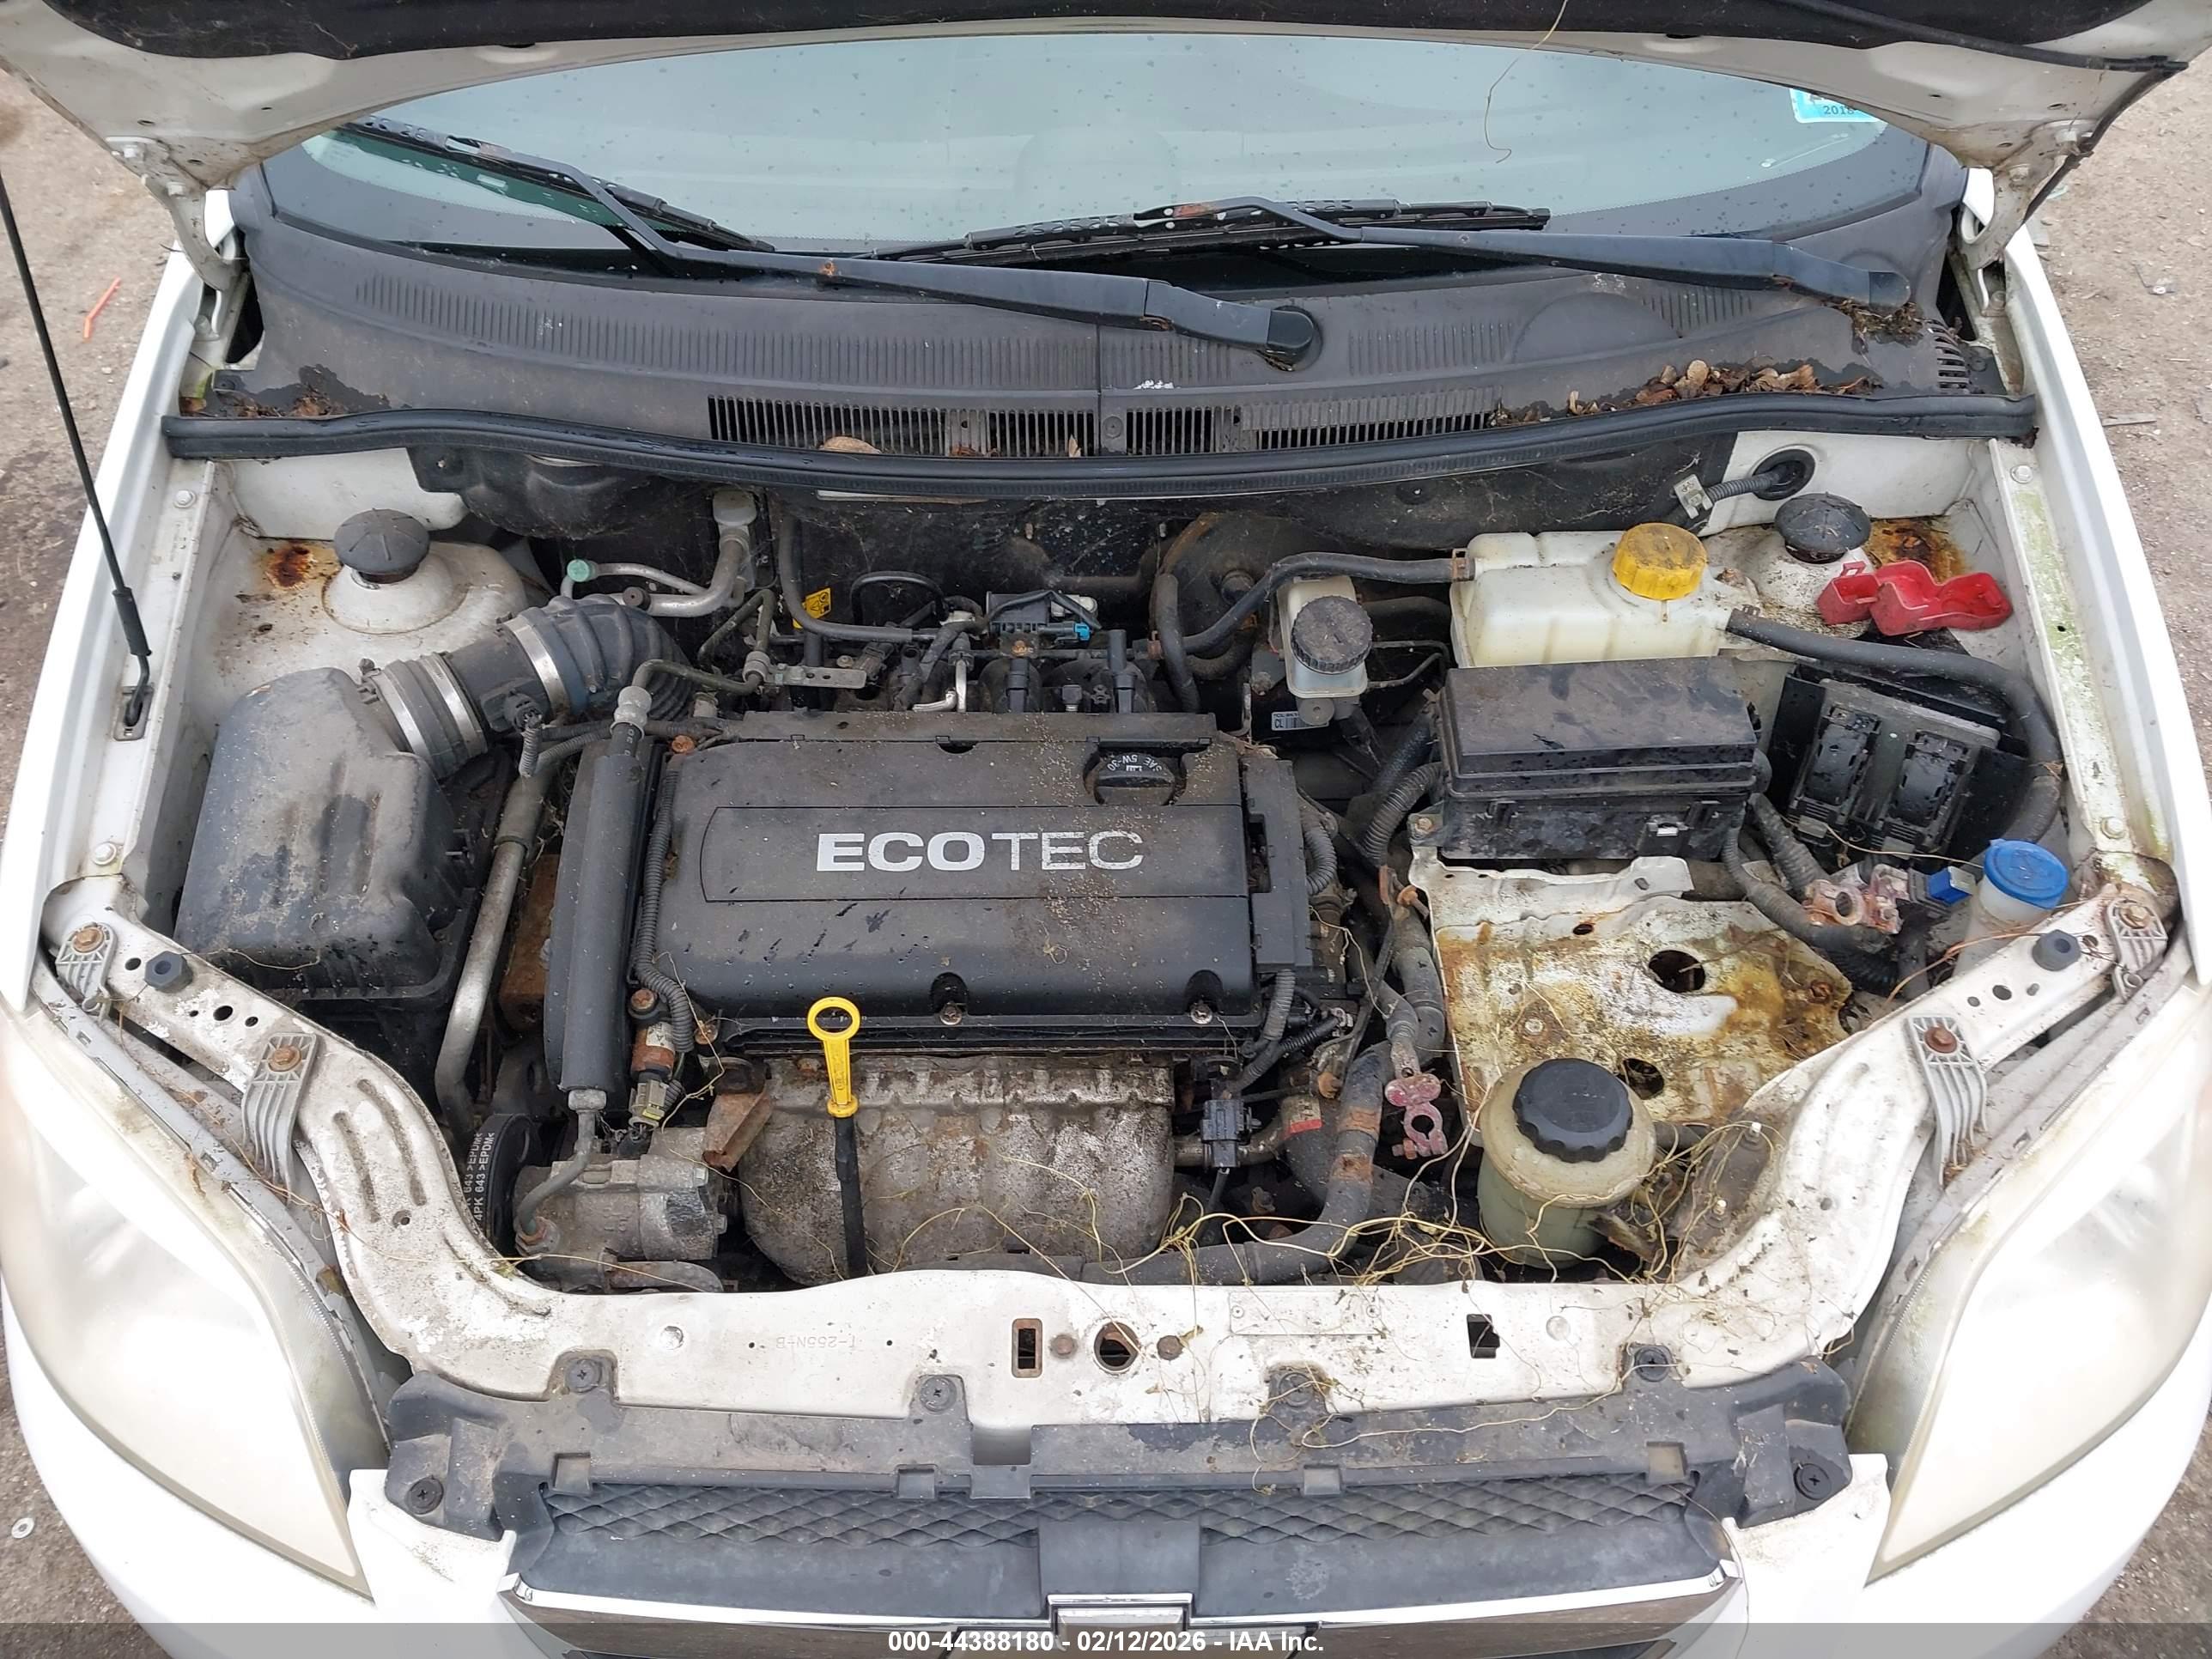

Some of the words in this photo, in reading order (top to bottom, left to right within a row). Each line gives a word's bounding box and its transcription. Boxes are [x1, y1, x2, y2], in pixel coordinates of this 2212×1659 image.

[1107, 754, 1138, 771] 5W-30
[816, 831, 1144, 872] ECOTEC
[475, 1173, 486, 1193] 643
[474, 1197, 483, 1220] 4PK
